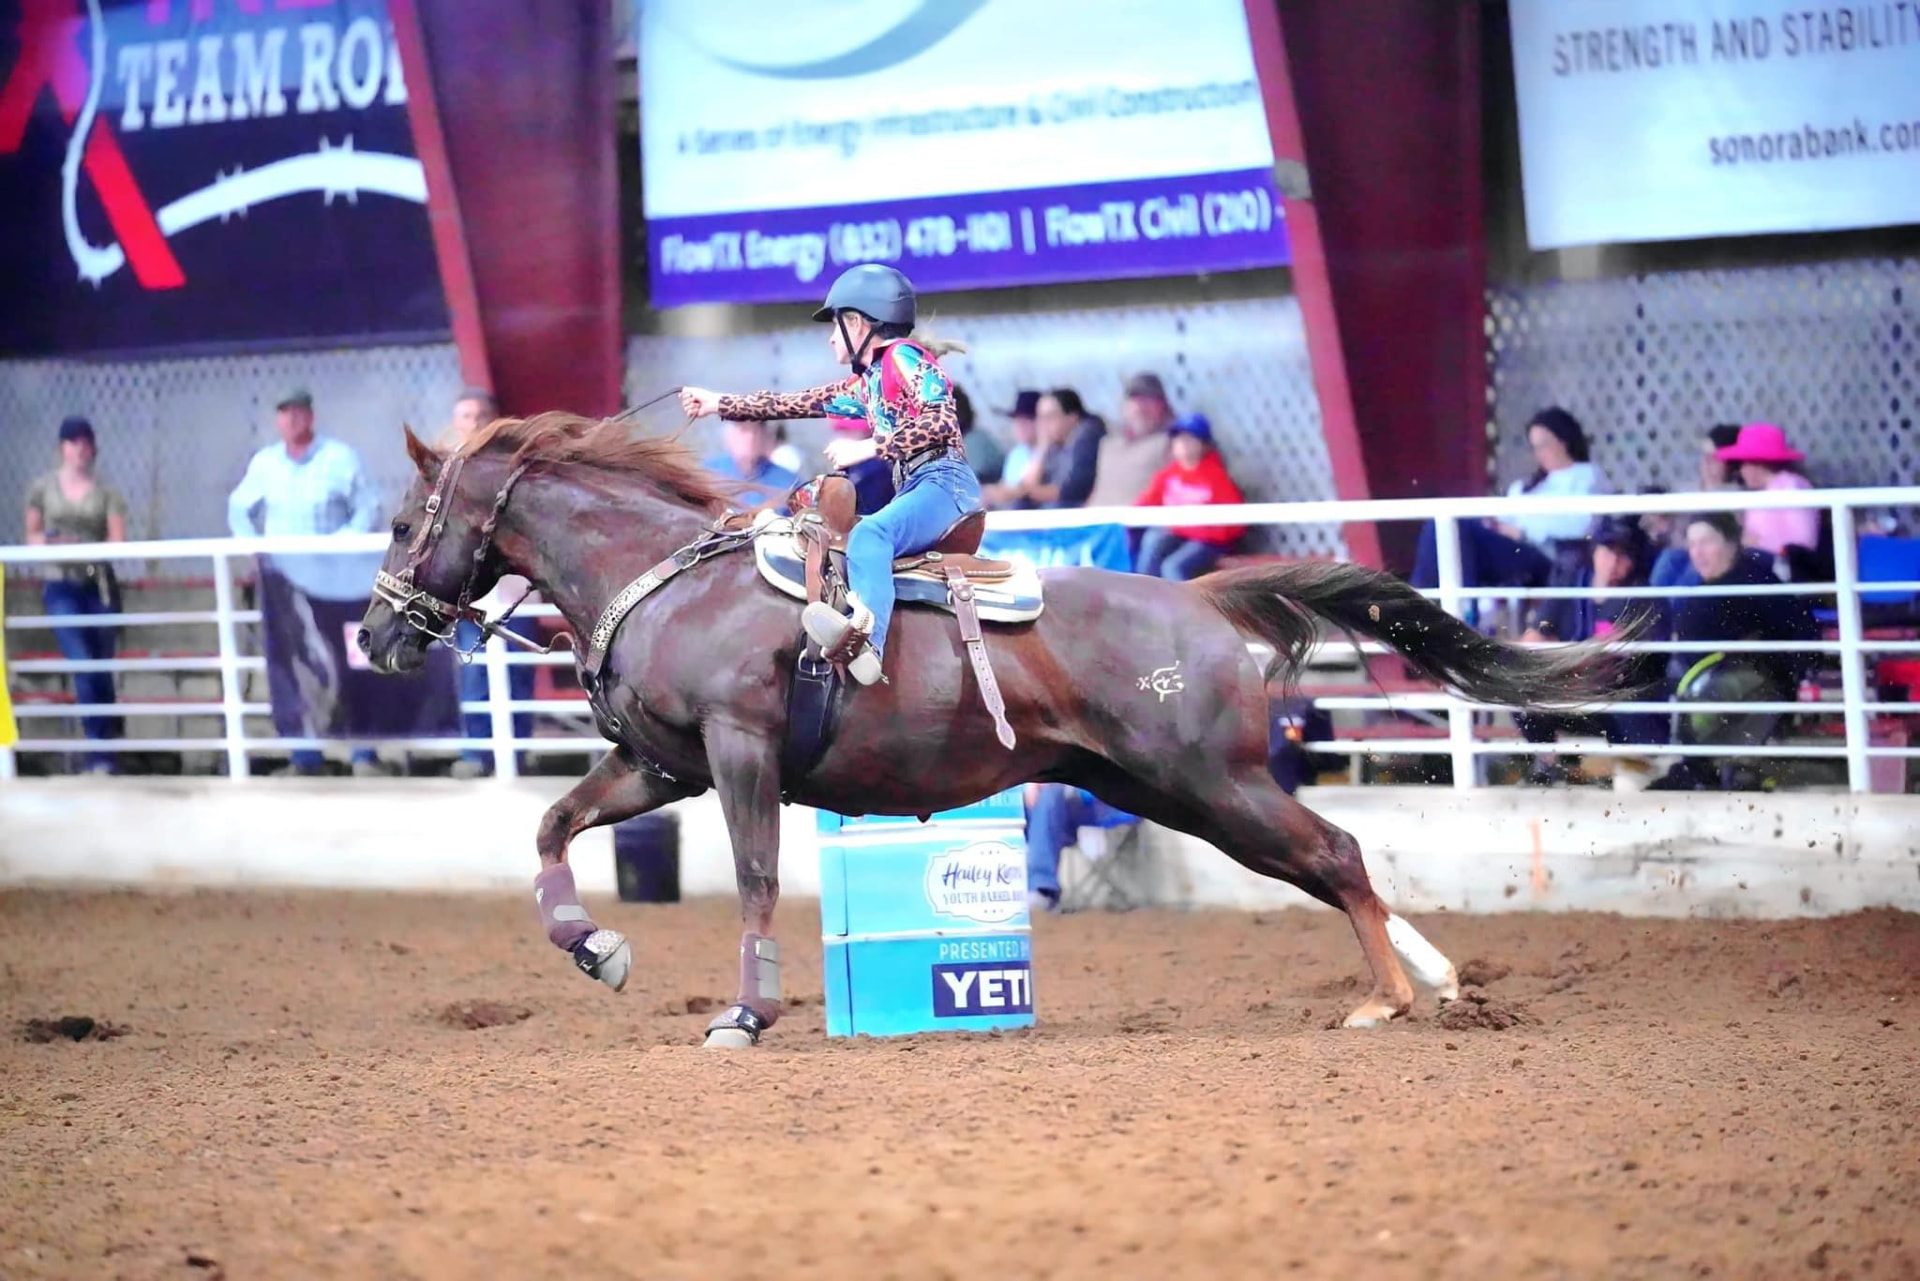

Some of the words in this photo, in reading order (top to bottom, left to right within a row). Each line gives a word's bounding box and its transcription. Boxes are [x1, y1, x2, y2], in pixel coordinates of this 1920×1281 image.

[1553, 22, 1699, 77] STRENGTH
[1710, 17, 1771, 61] AND
[117, 27, 288, 131] TEAM
[744, 229, 826, 284] Energy
[1139, 193, 1201, 241] Civil
[942, 862, 992, 890] Hailey
[943, 891, 978, 905] YOUTH
[940, 940, 1019, 961] PRESENTED
[941, 969, 1031, 1009] YETI
